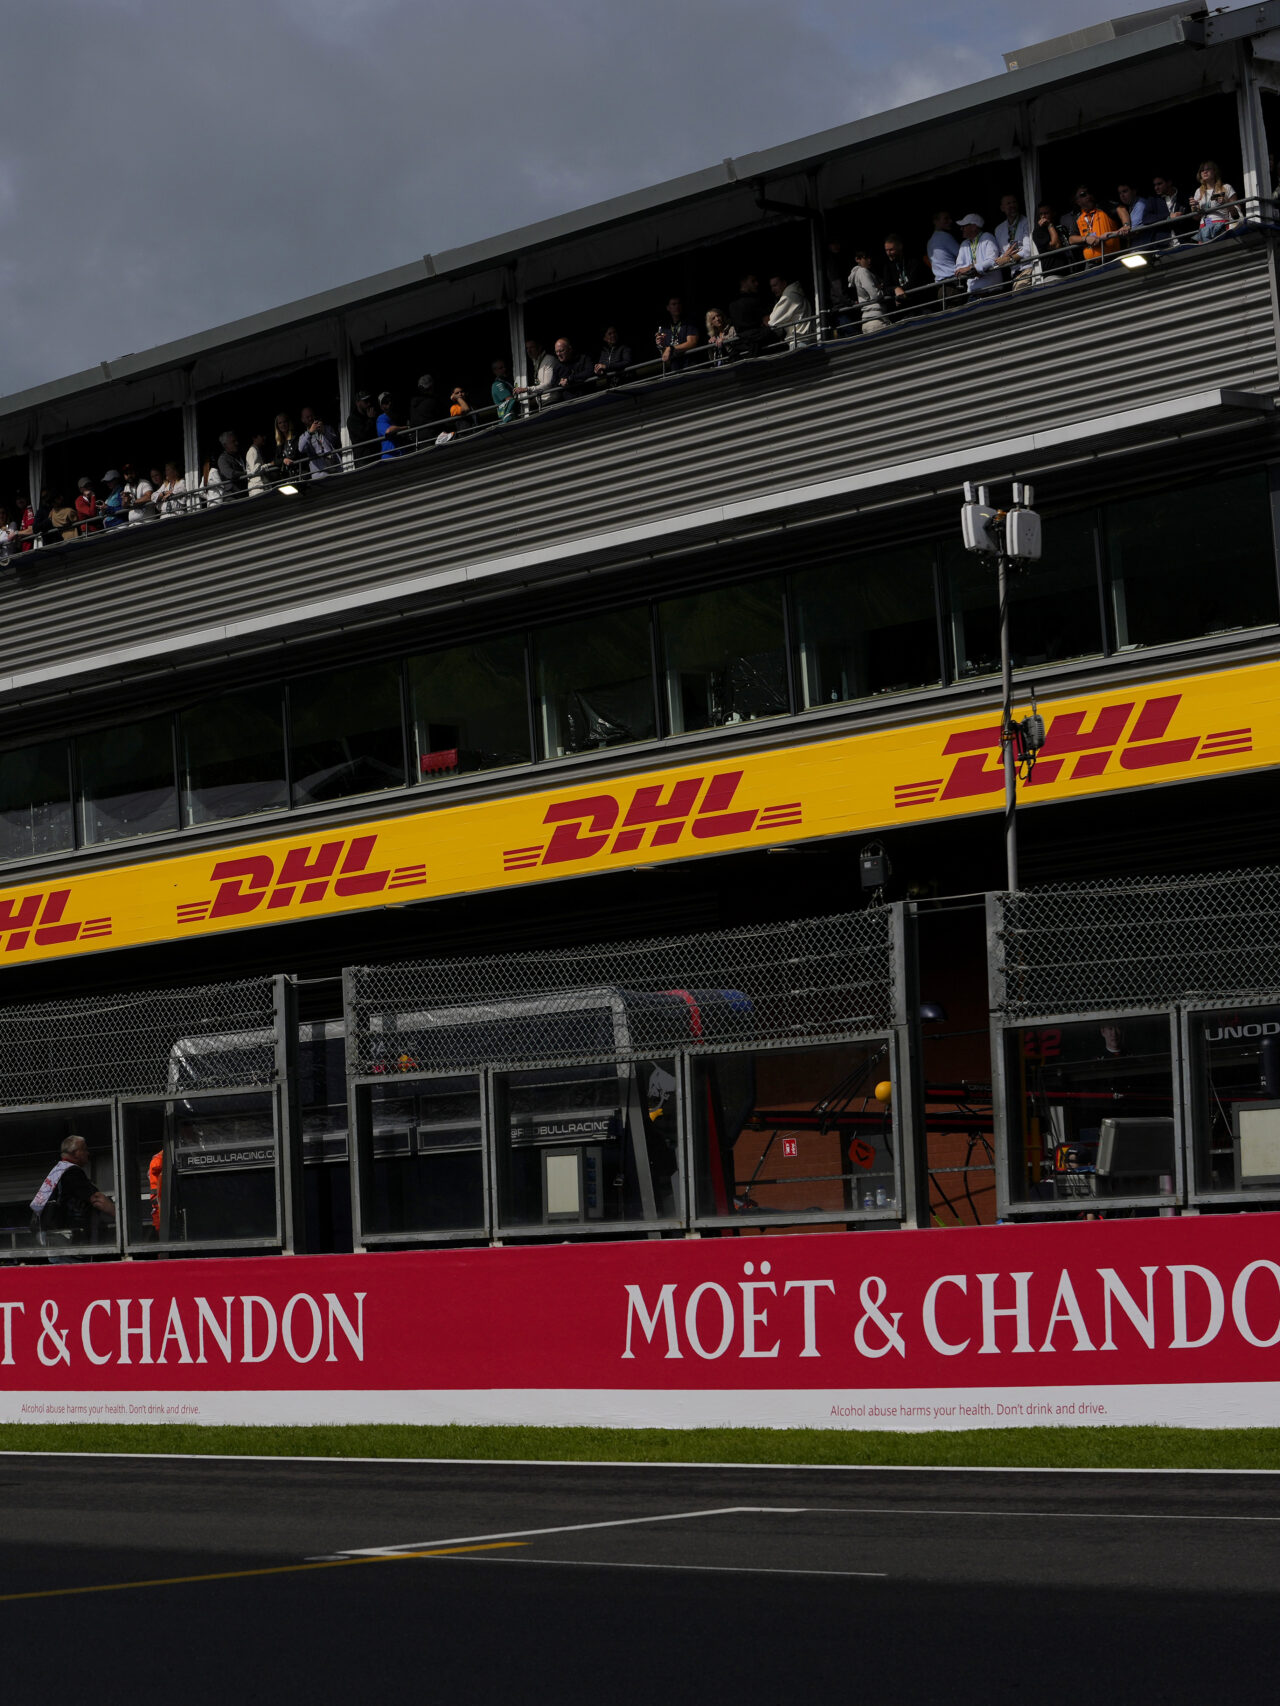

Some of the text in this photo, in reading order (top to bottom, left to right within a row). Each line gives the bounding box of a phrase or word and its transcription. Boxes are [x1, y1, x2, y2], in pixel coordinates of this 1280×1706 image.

[941, 695, 1202, 801] DHL
[542, 771, 760, 866] DHL
[209, 835, 391, 919] DHL
[36, 1299, 71, 1368] &
[81, 1292, 368, 1365] CHANDON
[620, 1260, 836, 1361] MOËT
[853, 1275, 907, 1360] &
[21, 1404, 201, 1417] Alcohol abuse harms your health. Don't drink and drive.
[830, 1404, 1108, 1420] Alcohol abuse harms your health. Don't drink and drive.
